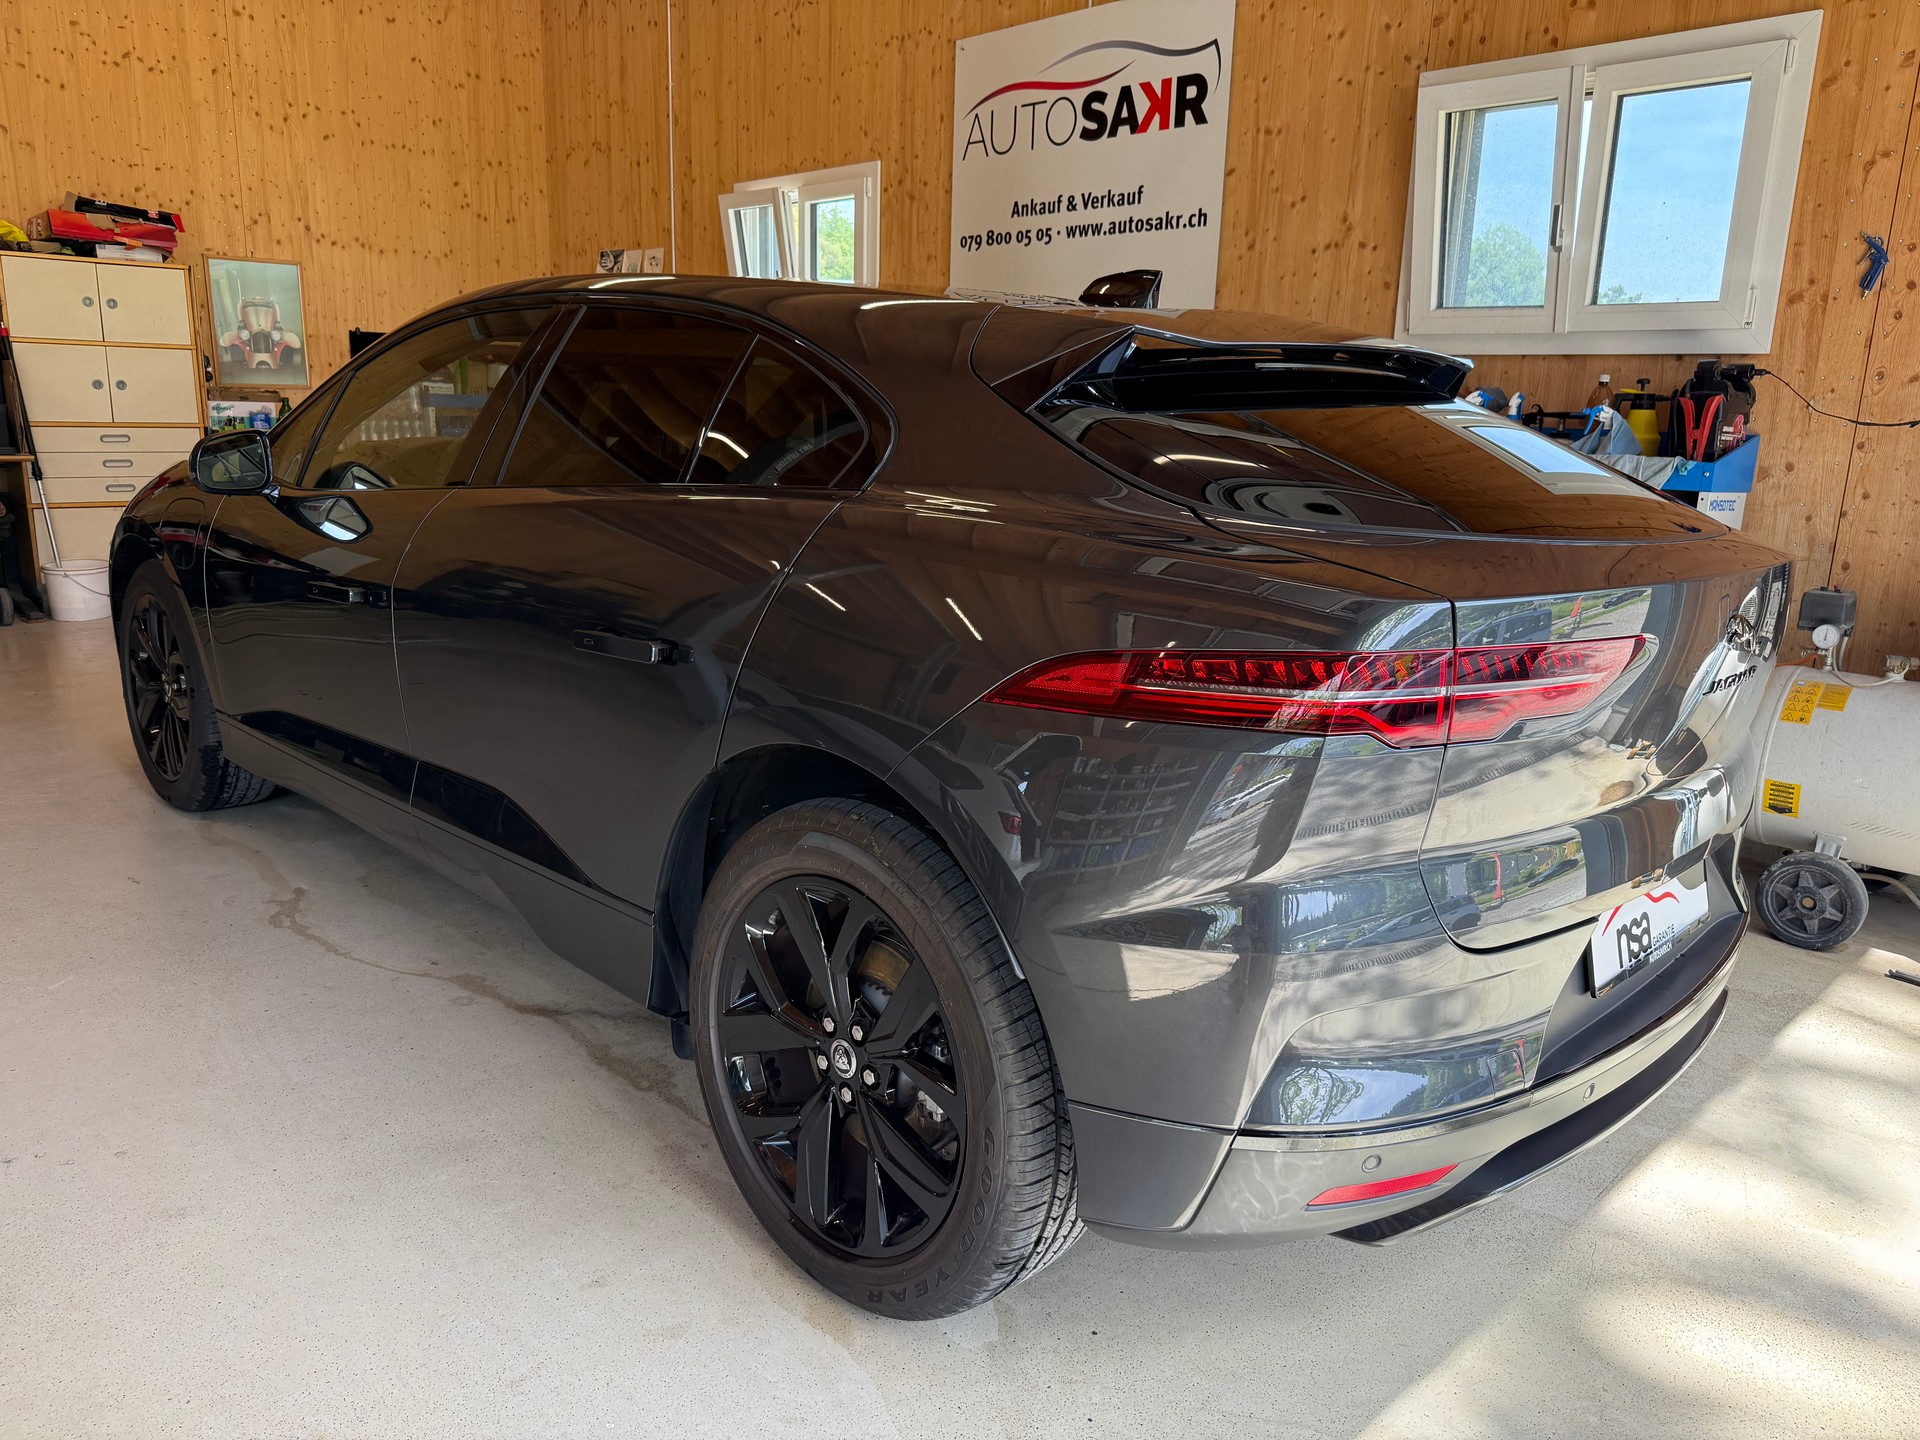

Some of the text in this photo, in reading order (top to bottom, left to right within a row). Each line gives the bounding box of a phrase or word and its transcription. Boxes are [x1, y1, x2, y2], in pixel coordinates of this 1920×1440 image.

[1011, 185, 1144, 218] Ankauf & Verkauf
[960, 234, 983, 252] 079
[986, 230, 1012, 246] 800
[1016, 229, 1032, 247] 05
[1036, 227, 1052, 245] 05
[1066, 208, 1208, 239] www.autosakr.ch
[1702, 664, 1758, 696] JAGUAR
[1616, 911, 1652, 970] nsa
[866, 1126, 996, 1302] GOODYEAR
